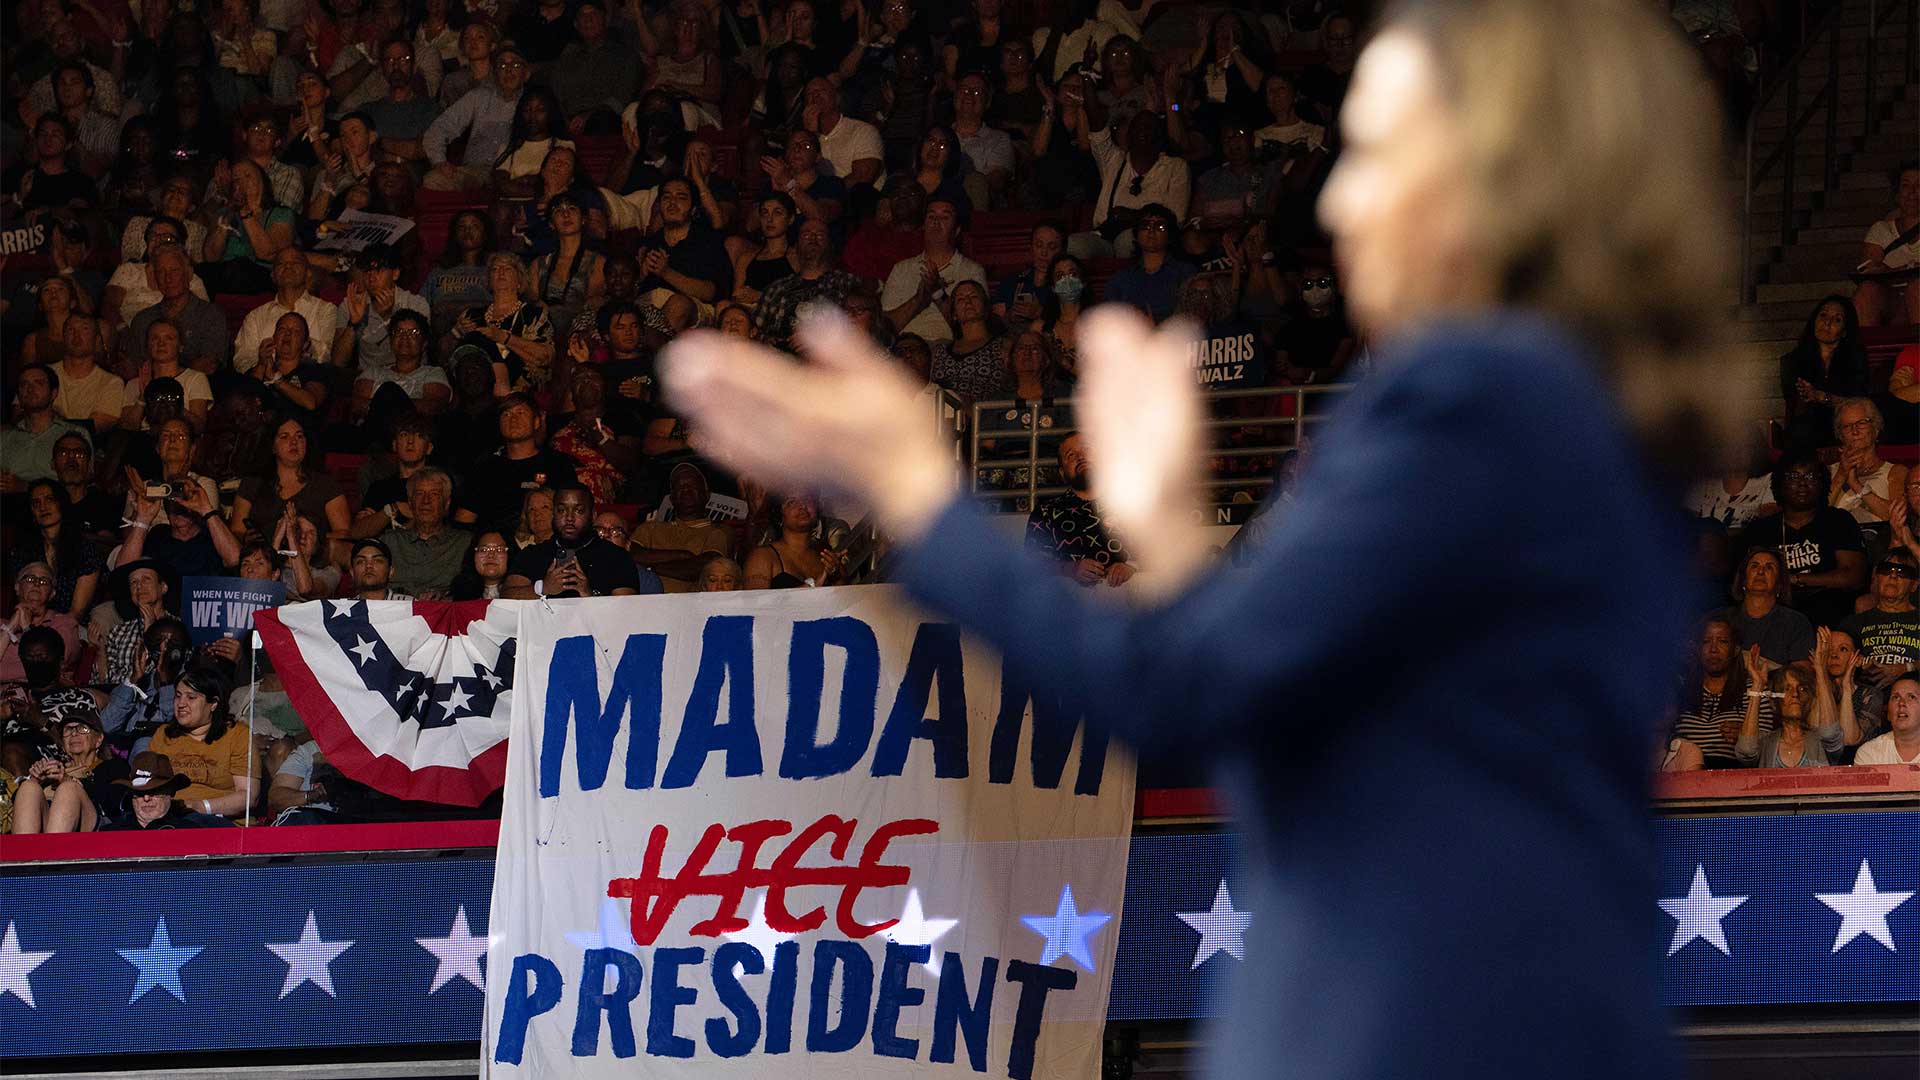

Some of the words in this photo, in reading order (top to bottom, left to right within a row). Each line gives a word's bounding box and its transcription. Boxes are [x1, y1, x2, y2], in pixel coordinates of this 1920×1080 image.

[0, 224, 46, 256] RRIS
[1197, 364, 1245, 384] WALZ
[1784, 543, 1820, 562] HILLY
[1785, 552, 1821, 569] HING
[192, 589, 223, 600] WHEN
[223, 590, 241, 600] WE
[241, 592, 274, 603] FIGHT
[191, 601, 223, 628] WE
[540, 615, 1111, 797] MADAM
[618, 814, 939, 946] VICE
[494, 940, 1078, 1080] PRESIDENT
